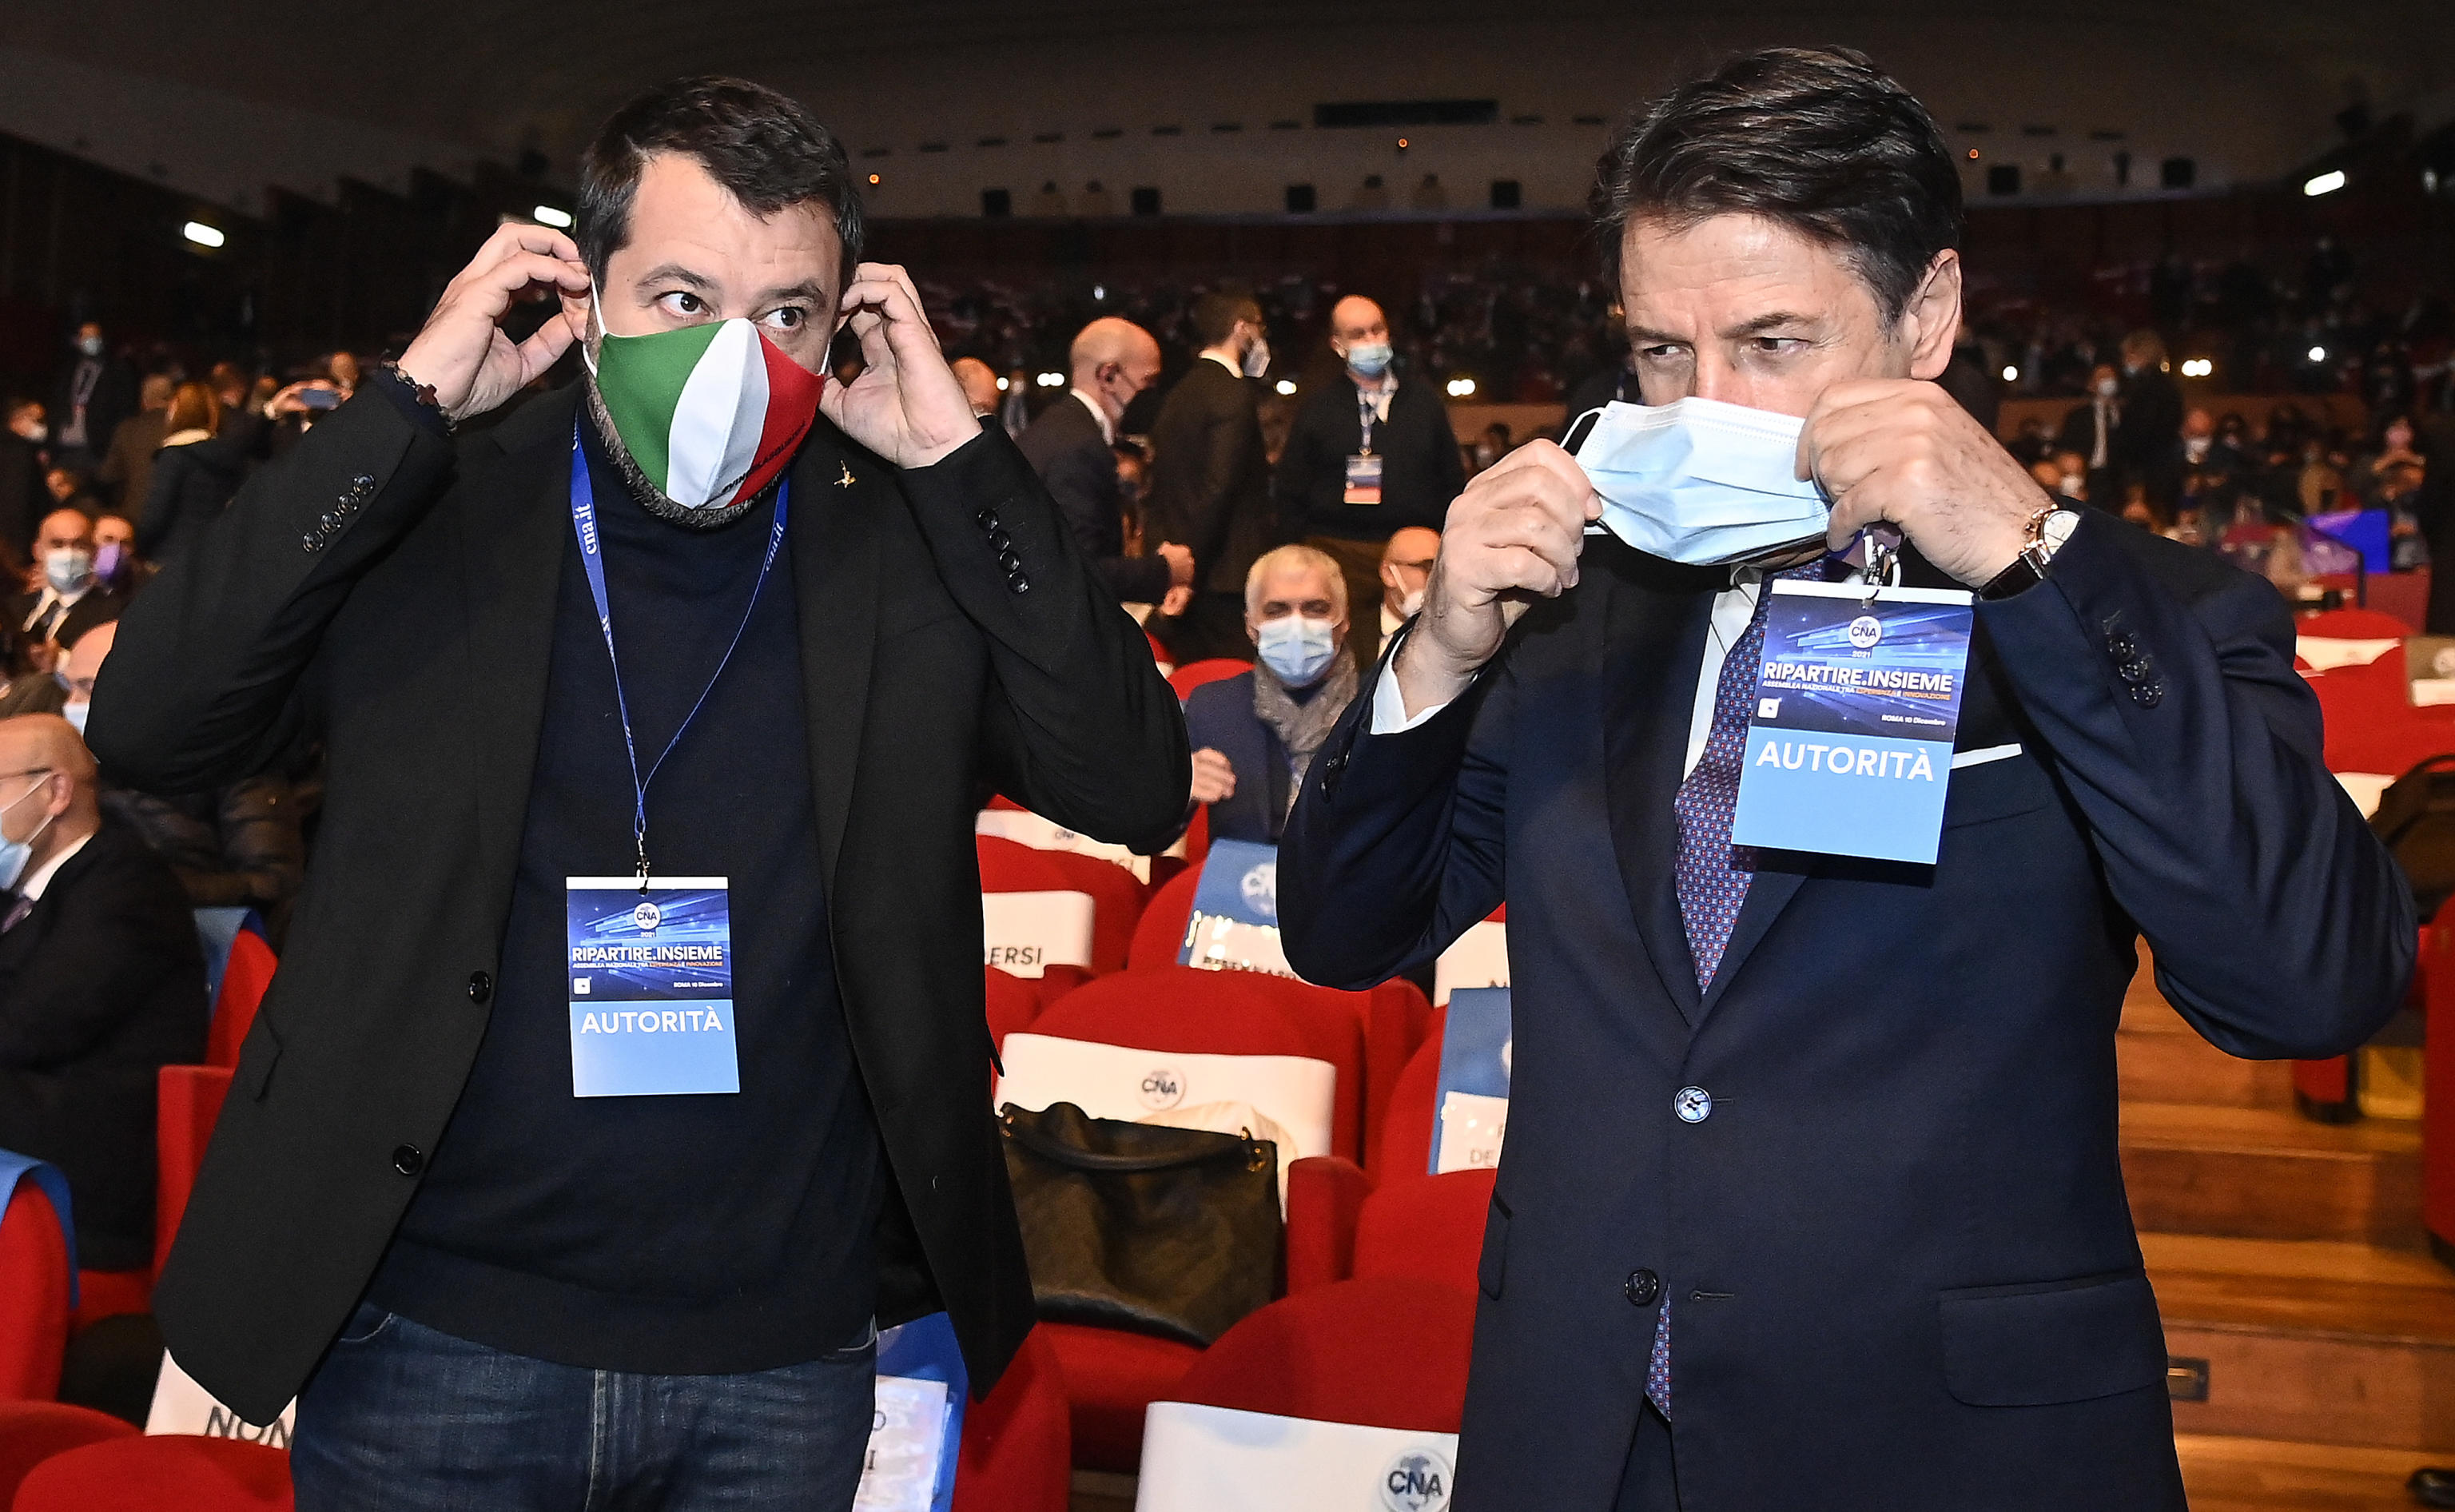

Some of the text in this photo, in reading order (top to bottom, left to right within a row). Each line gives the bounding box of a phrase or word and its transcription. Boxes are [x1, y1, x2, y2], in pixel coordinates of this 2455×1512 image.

[575, 503, 597, 555] cna.it
[1852, 627, 1876, 638] CNA
[1756, 741, 1934, 782] AUTORITÀ
[636, 911, 657, 921] CNA
[580, 1006, 723, 1034] AUTORITÀ
[1388, 1470, 1443, 1496] CNA
